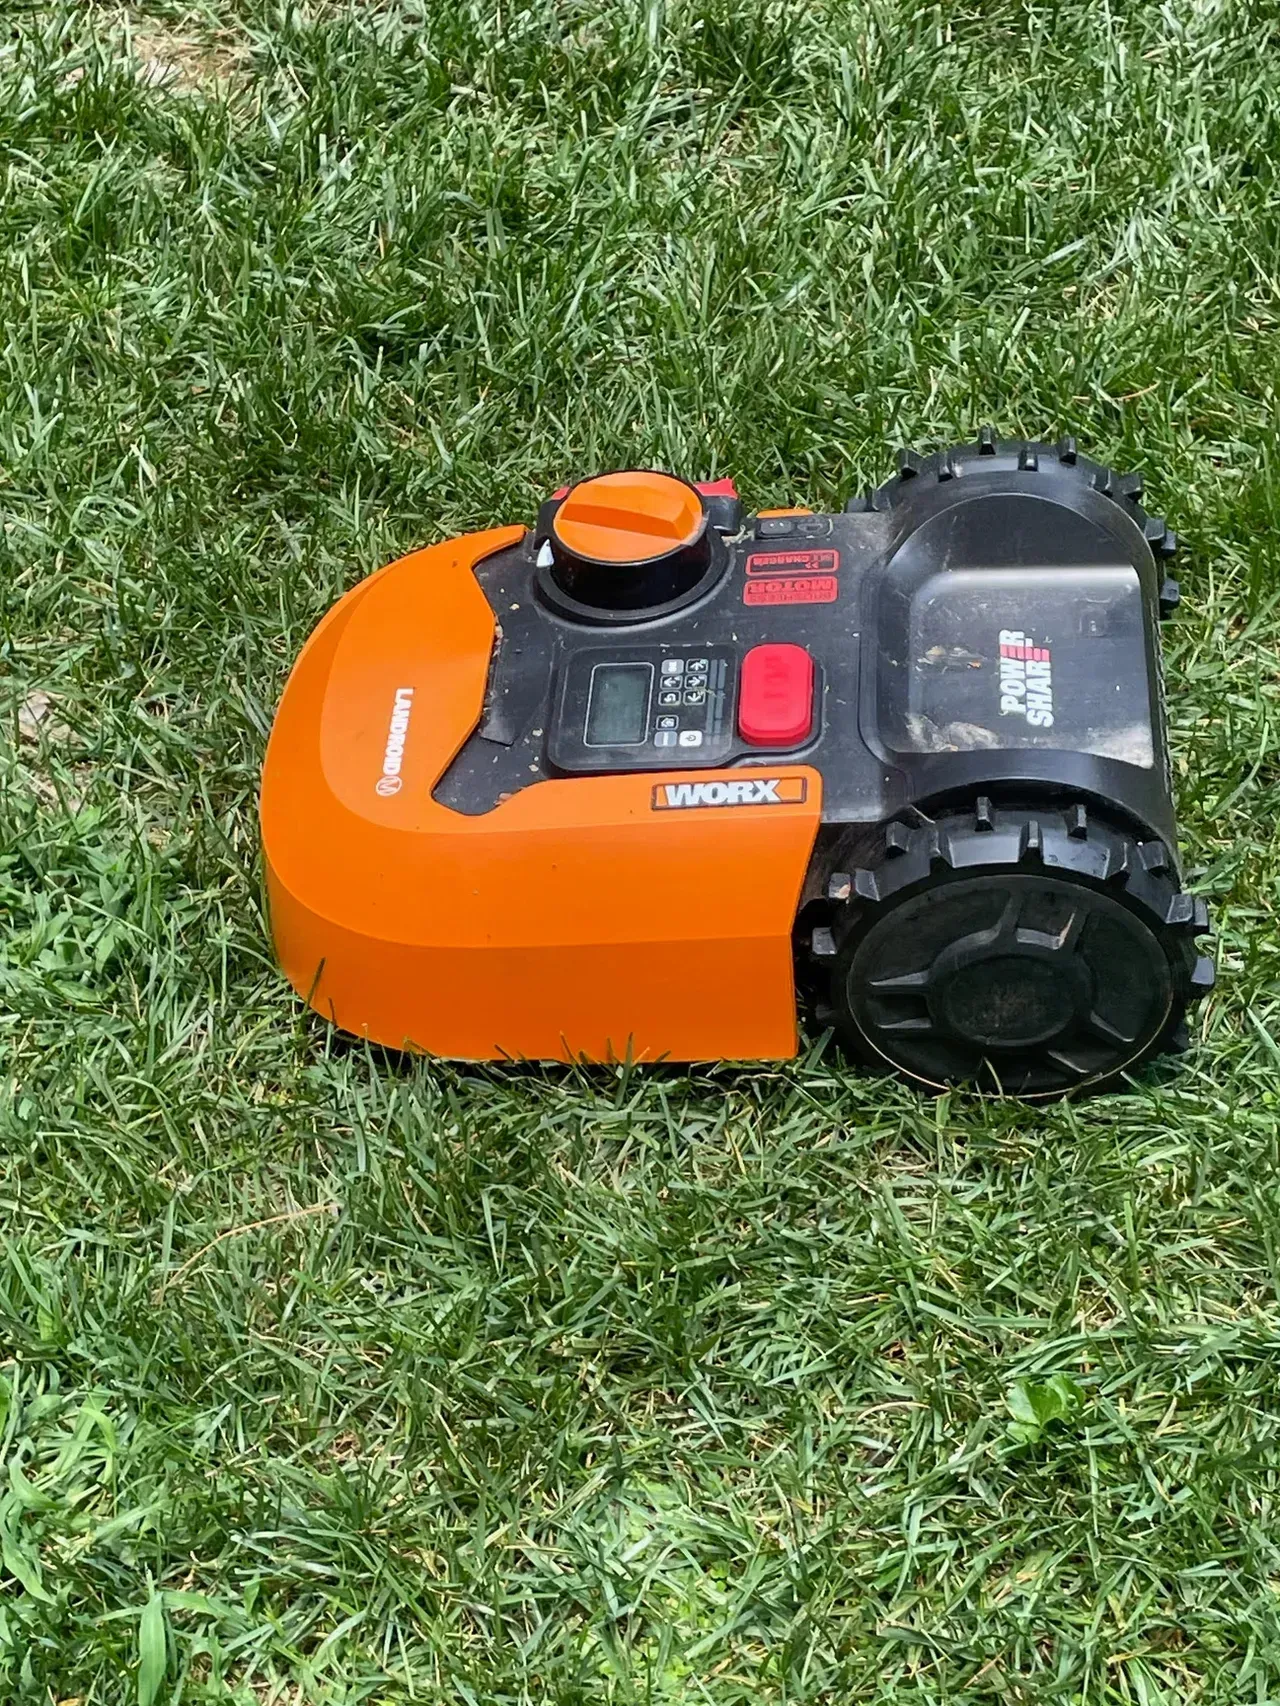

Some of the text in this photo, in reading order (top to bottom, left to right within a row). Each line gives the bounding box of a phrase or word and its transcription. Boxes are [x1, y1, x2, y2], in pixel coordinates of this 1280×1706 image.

[748, 579, 834, 594] MOTOR
[999, 630, 1026, 714] POWER
[1025, 638, 1054, 728] SHARE
[383, 688, 414, 775] LANDROID
[664, 778, 781, 806] WORX
